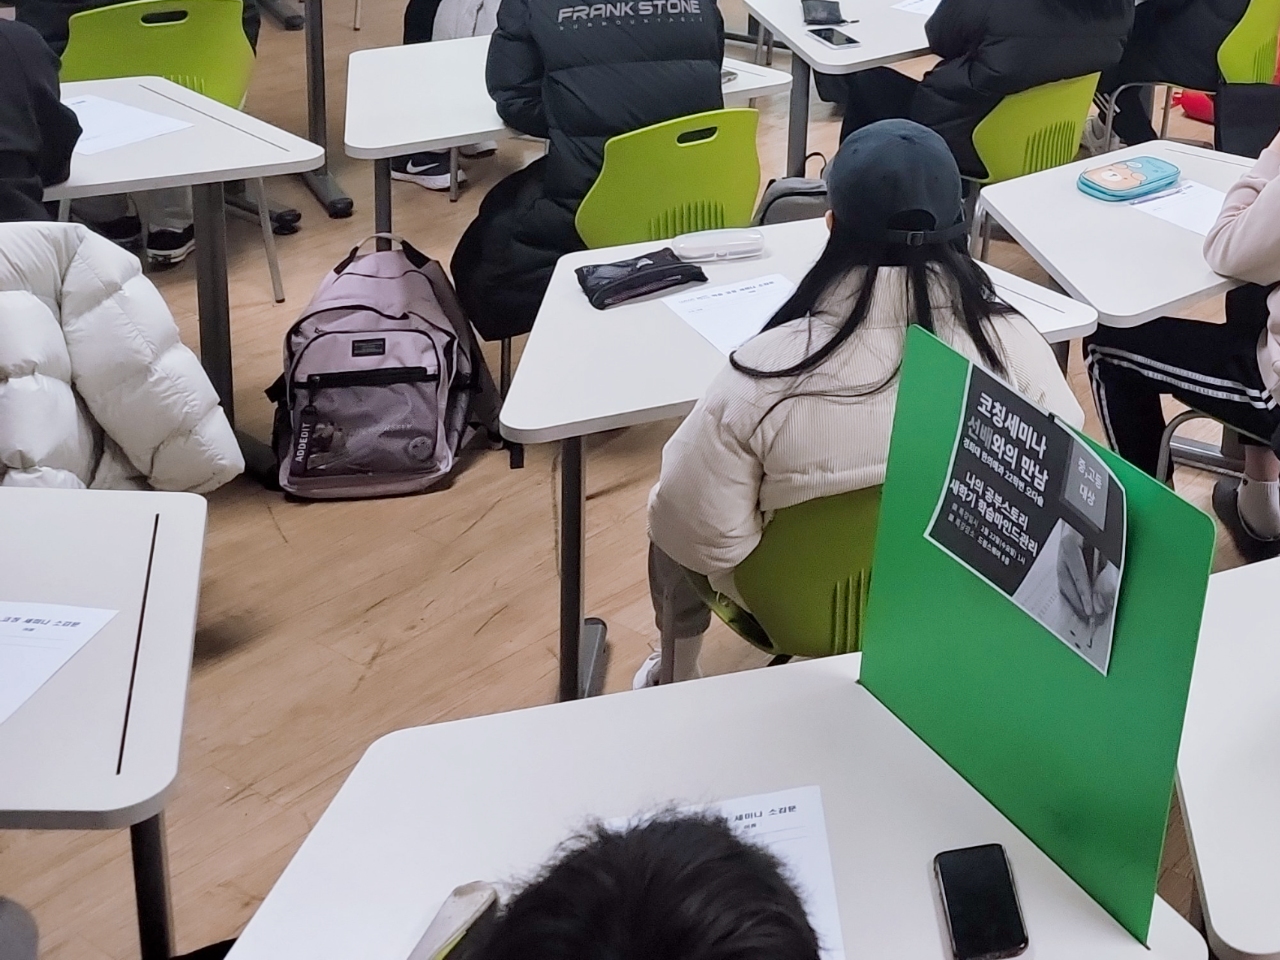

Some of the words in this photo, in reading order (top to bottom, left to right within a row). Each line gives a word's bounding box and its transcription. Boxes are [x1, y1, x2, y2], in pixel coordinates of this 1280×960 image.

[558, 2, 634, 23] FRANK
[638, 0, 701, 15] STONE
[295, 422, 311, 462] ADDEDIT
[967, 415, 1019, 470] 선배와의
[1021, 455, 1049, 492] 만남
[977, 392, 1047, 460] 코칭세미나
[949, 478, 977, 508] 새학기
[978, 498, 1038, 557] 학습마인드관리
[966, 471, 984, 496] 나의
[985, 486, 1029, 531] 공부스토리
[1079, 483, 1096, 506] 대상
